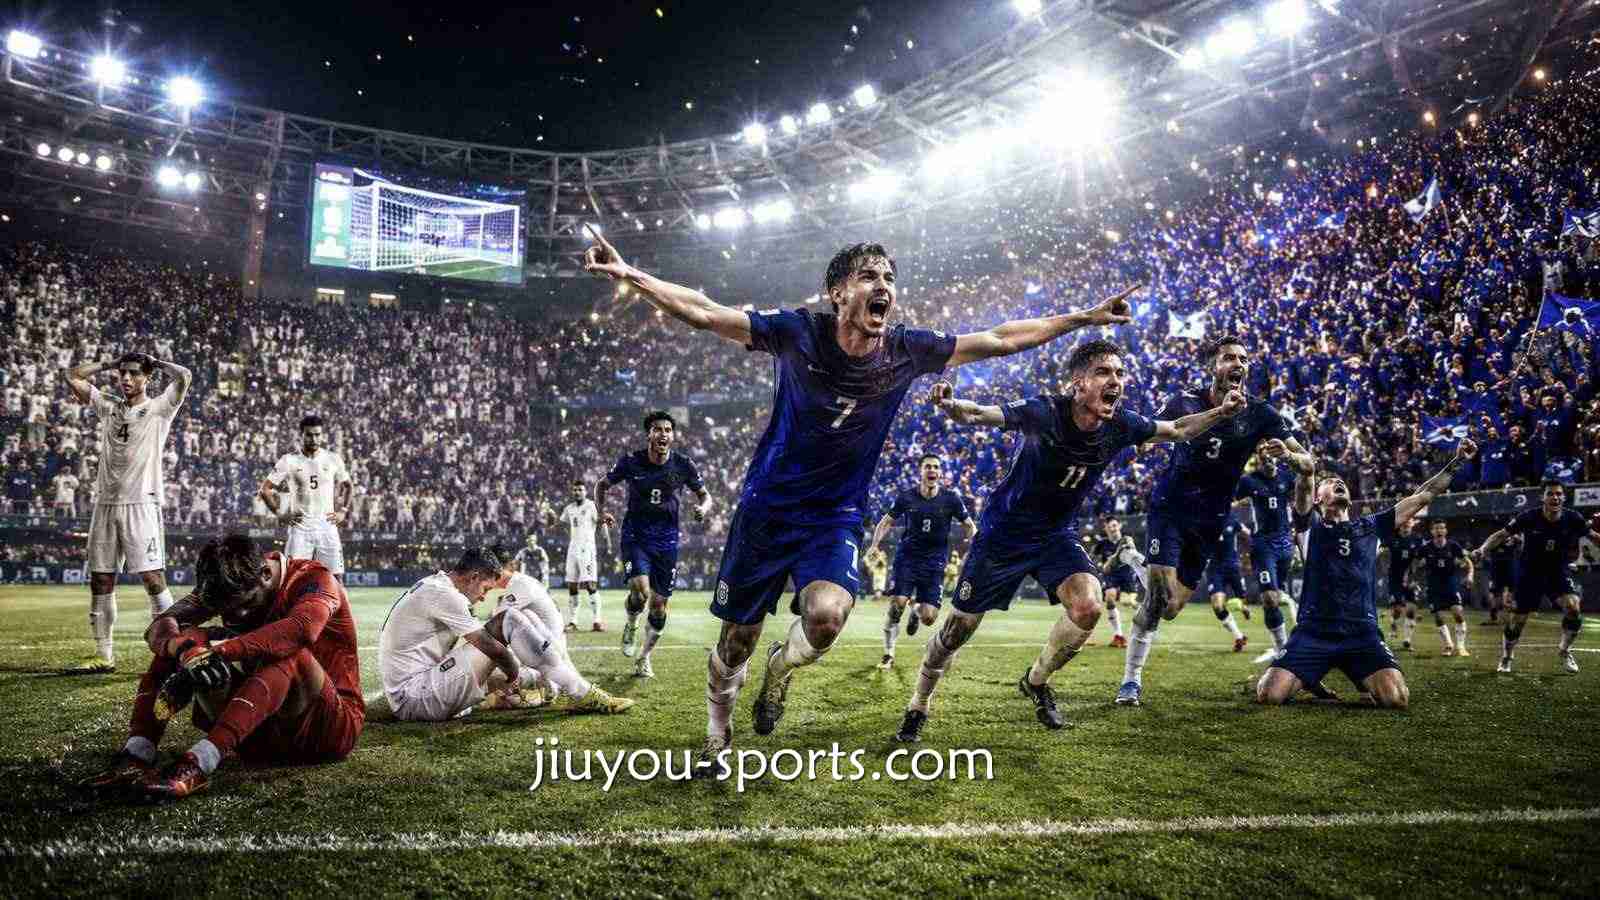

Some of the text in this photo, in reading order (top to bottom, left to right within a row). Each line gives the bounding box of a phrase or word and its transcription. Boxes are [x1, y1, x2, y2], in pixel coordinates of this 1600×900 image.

[831, 396, 857, 429] 7
[117, 423, 130, 443] 4
[1205, 436, 1223, 460] 3
[309, 475, 319, 490] 5
[1058, 465, 1088, 489] 11
[1339, 538, 1351, 557] 3
